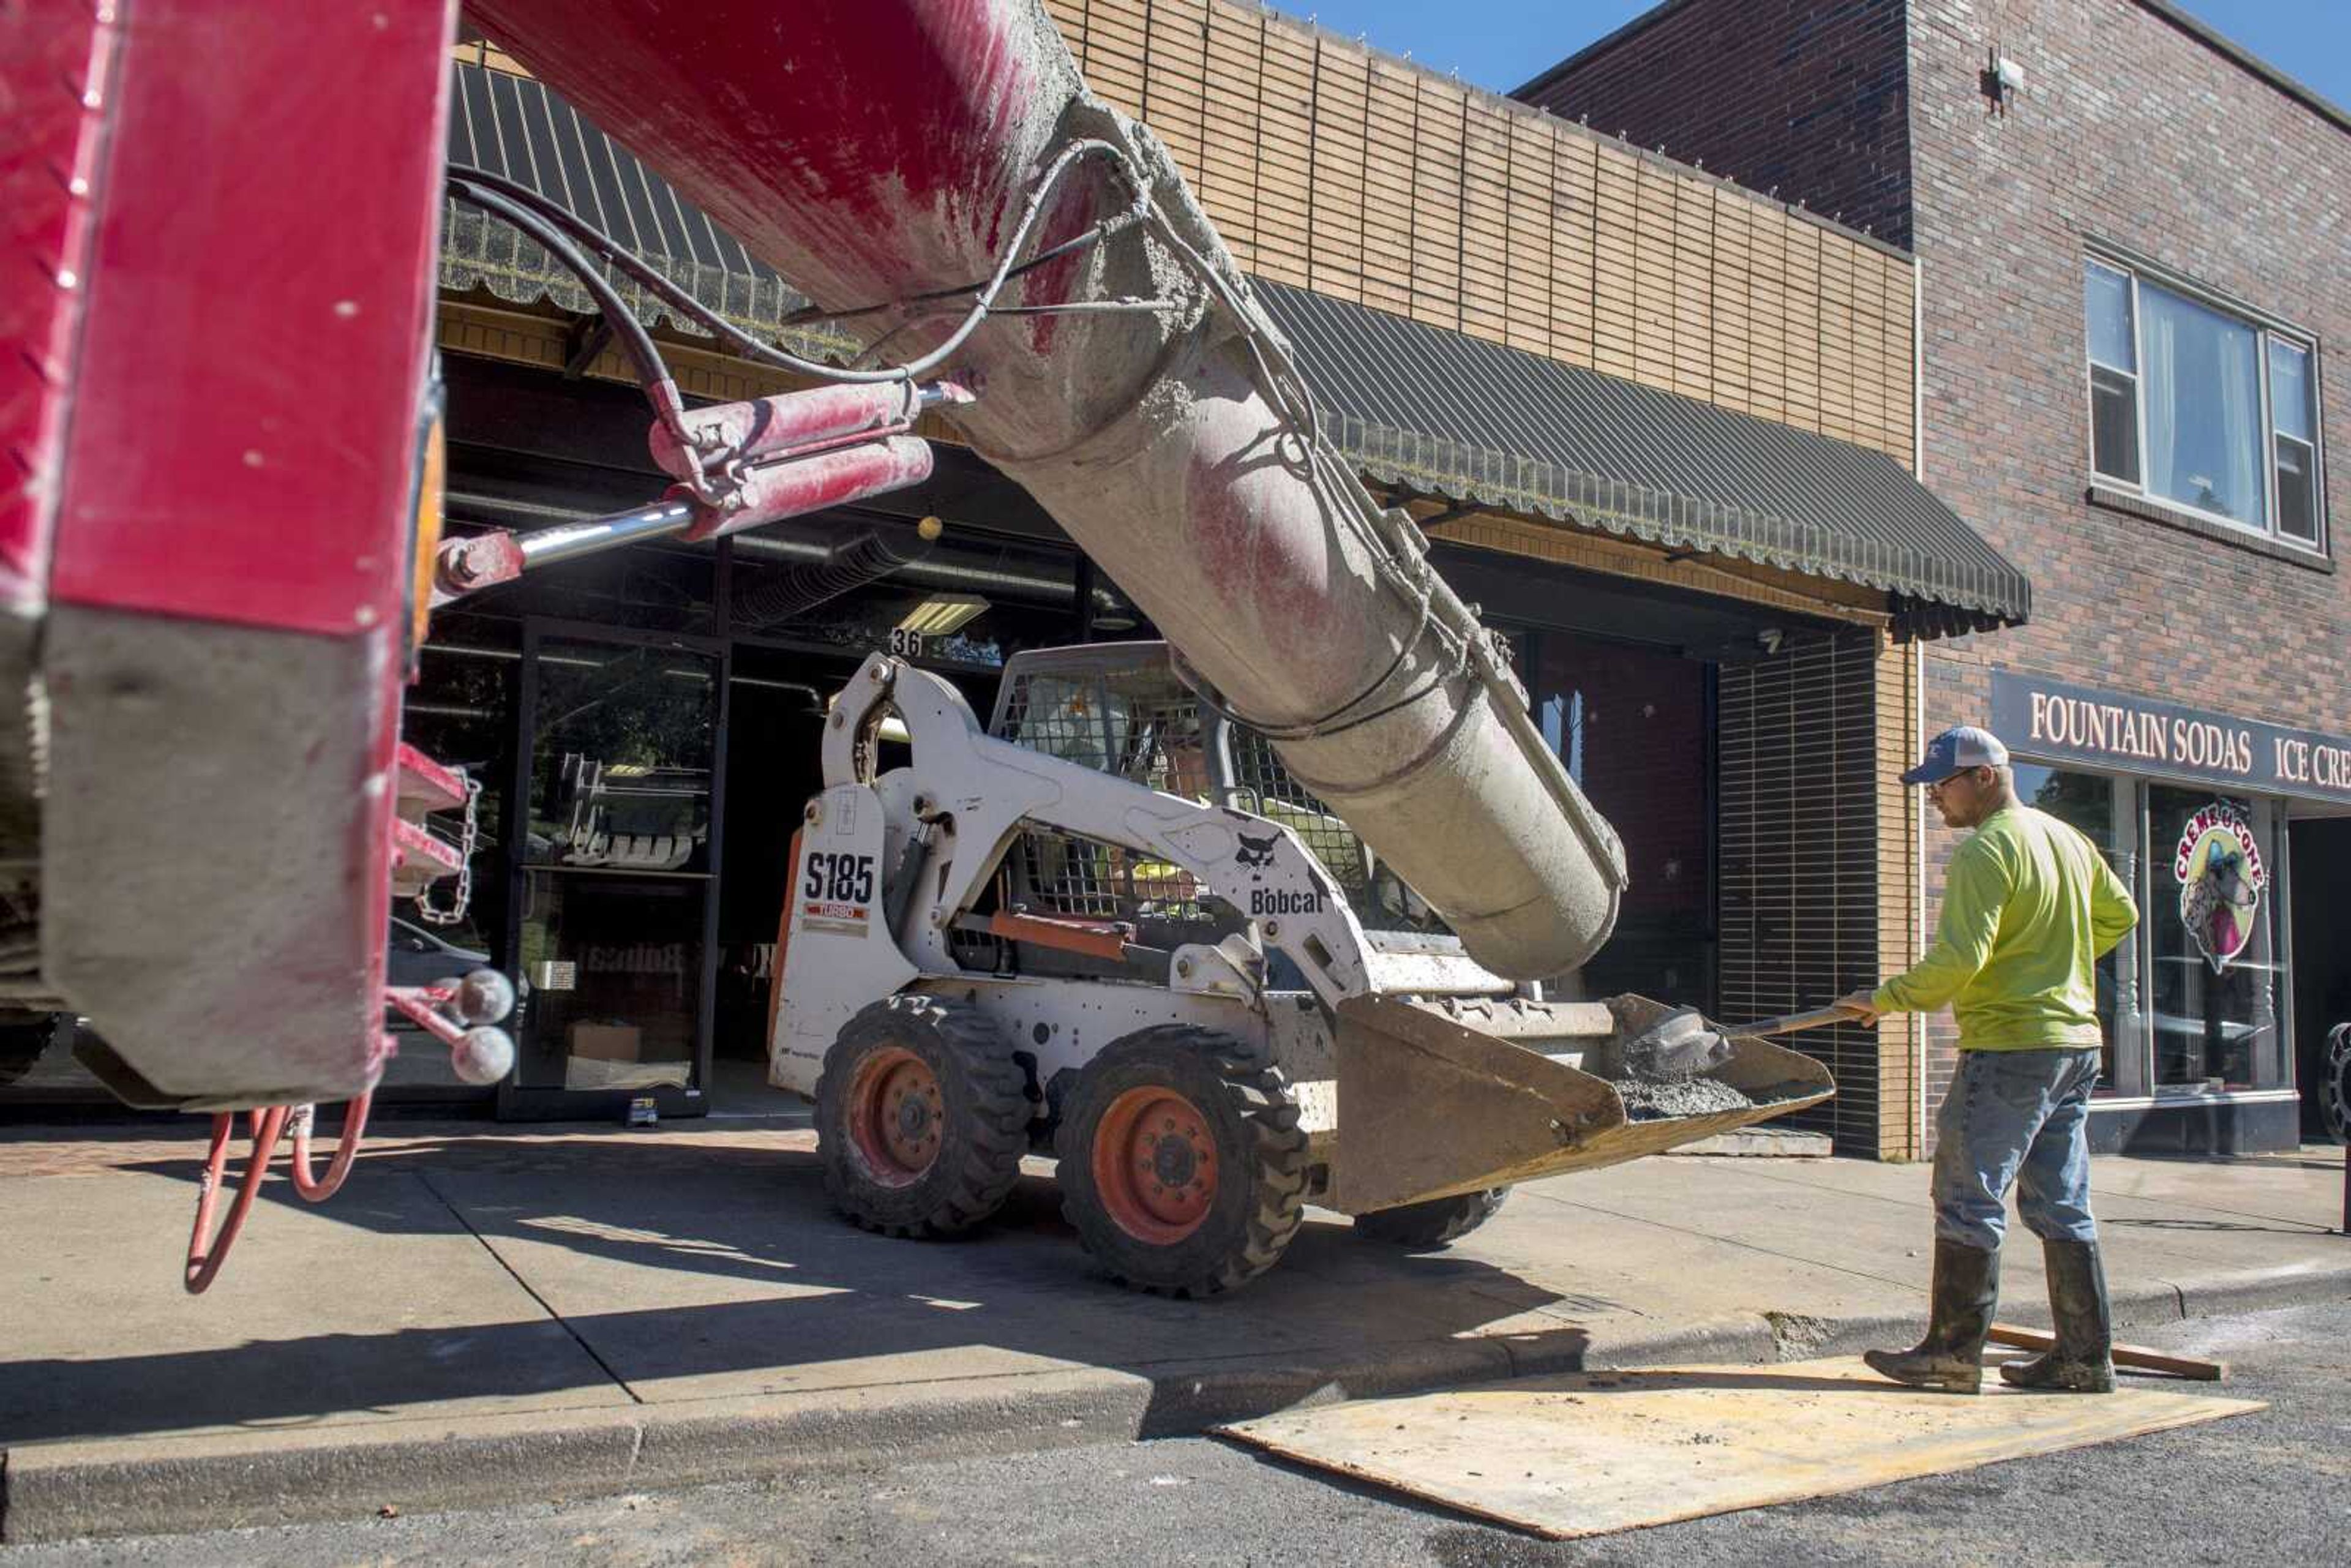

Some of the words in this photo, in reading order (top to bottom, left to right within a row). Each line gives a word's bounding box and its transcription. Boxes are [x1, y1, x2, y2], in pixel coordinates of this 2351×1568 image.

[894, 629, 919, 656] 36
[2030, 692, 2168, 760] FOUNTAIN
[2174, 718, 2252, 774] SODAS
[2274, 737, 2309, 781] ICE
[804, 852, 874, 904] S185
[2233, 819, 2264, 886] CONE
[1251, 888, 1323, 915] Bobcat
